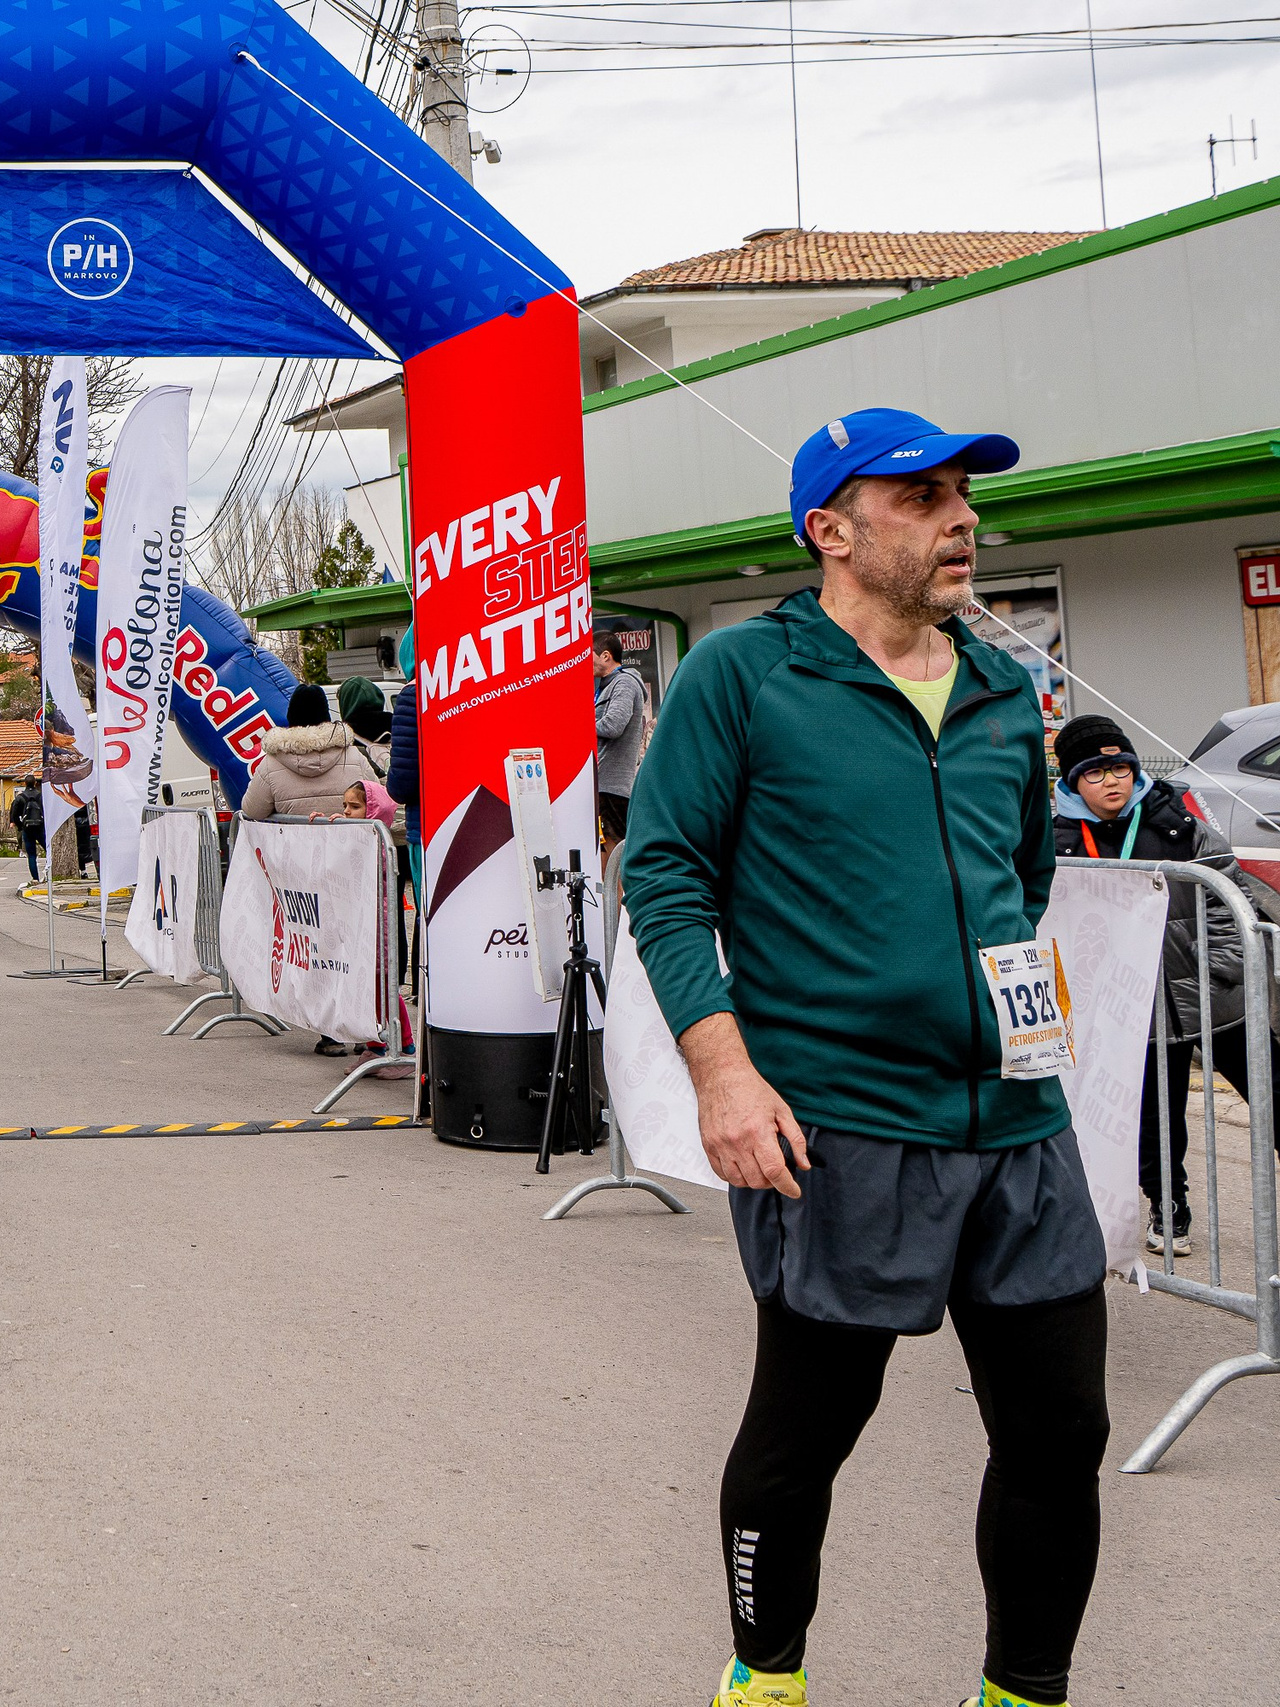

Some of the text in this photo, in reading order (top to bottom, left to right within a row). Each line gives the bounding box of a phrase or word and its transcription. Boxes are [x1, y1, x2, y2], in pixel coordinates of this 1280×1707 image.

[63, 244, 118, 270] P/H
[64, 272, 118, 280] MARKOVO
[890, 449, 924, 459] 2XU
[414, 475, 562, 600] EVERY
[483, 520, 588, 618] STEP
[103, 530, 163, 737] Woolona
[172, 623, 260, 731] Red
[437, 646, 592, 723] WWW.PLOVDIV-HILLS-IN-MARKOVO.COM
[1023, 948, 1039, 964] 12K
[999, 980, 1057, 1029] 1325
